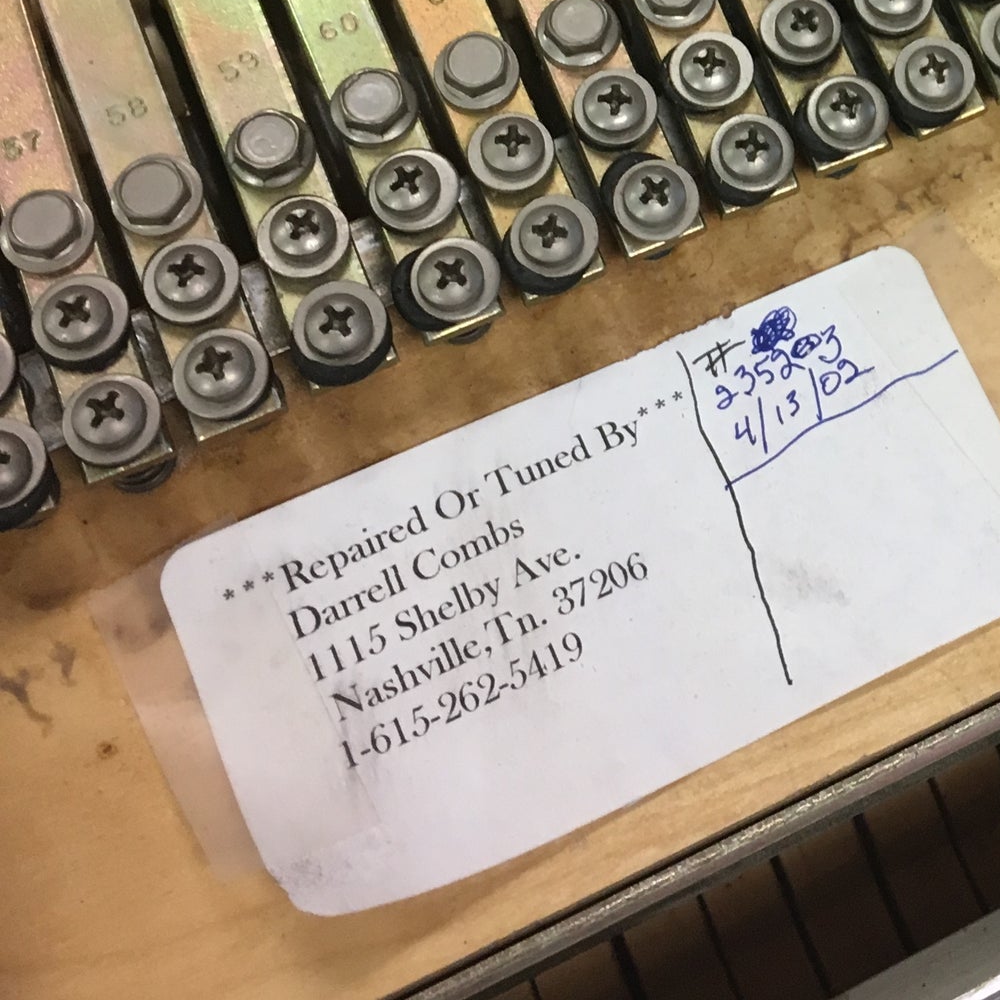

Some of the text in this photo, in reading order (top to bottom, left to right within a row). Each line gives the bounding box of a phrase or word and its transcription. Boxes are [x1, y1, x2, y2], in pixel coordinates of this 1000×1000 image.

[217, 51, 260, 83] 59
[319, 11, 359, 41] 60
[105, 96, 148, 126] 58
[734, 358, 876, 455] 4/13/02
[434, 485, 481, 522] Or
[483, 434, 594, 500] Tuned
[287, 516, 526, 640] Darrell Combs
[308, 543, 582, 683] 1115 Shelby Ave.
[551, 551, 650, 617] 37206
[340, 630, 585, 770] 1-615-262-5419
